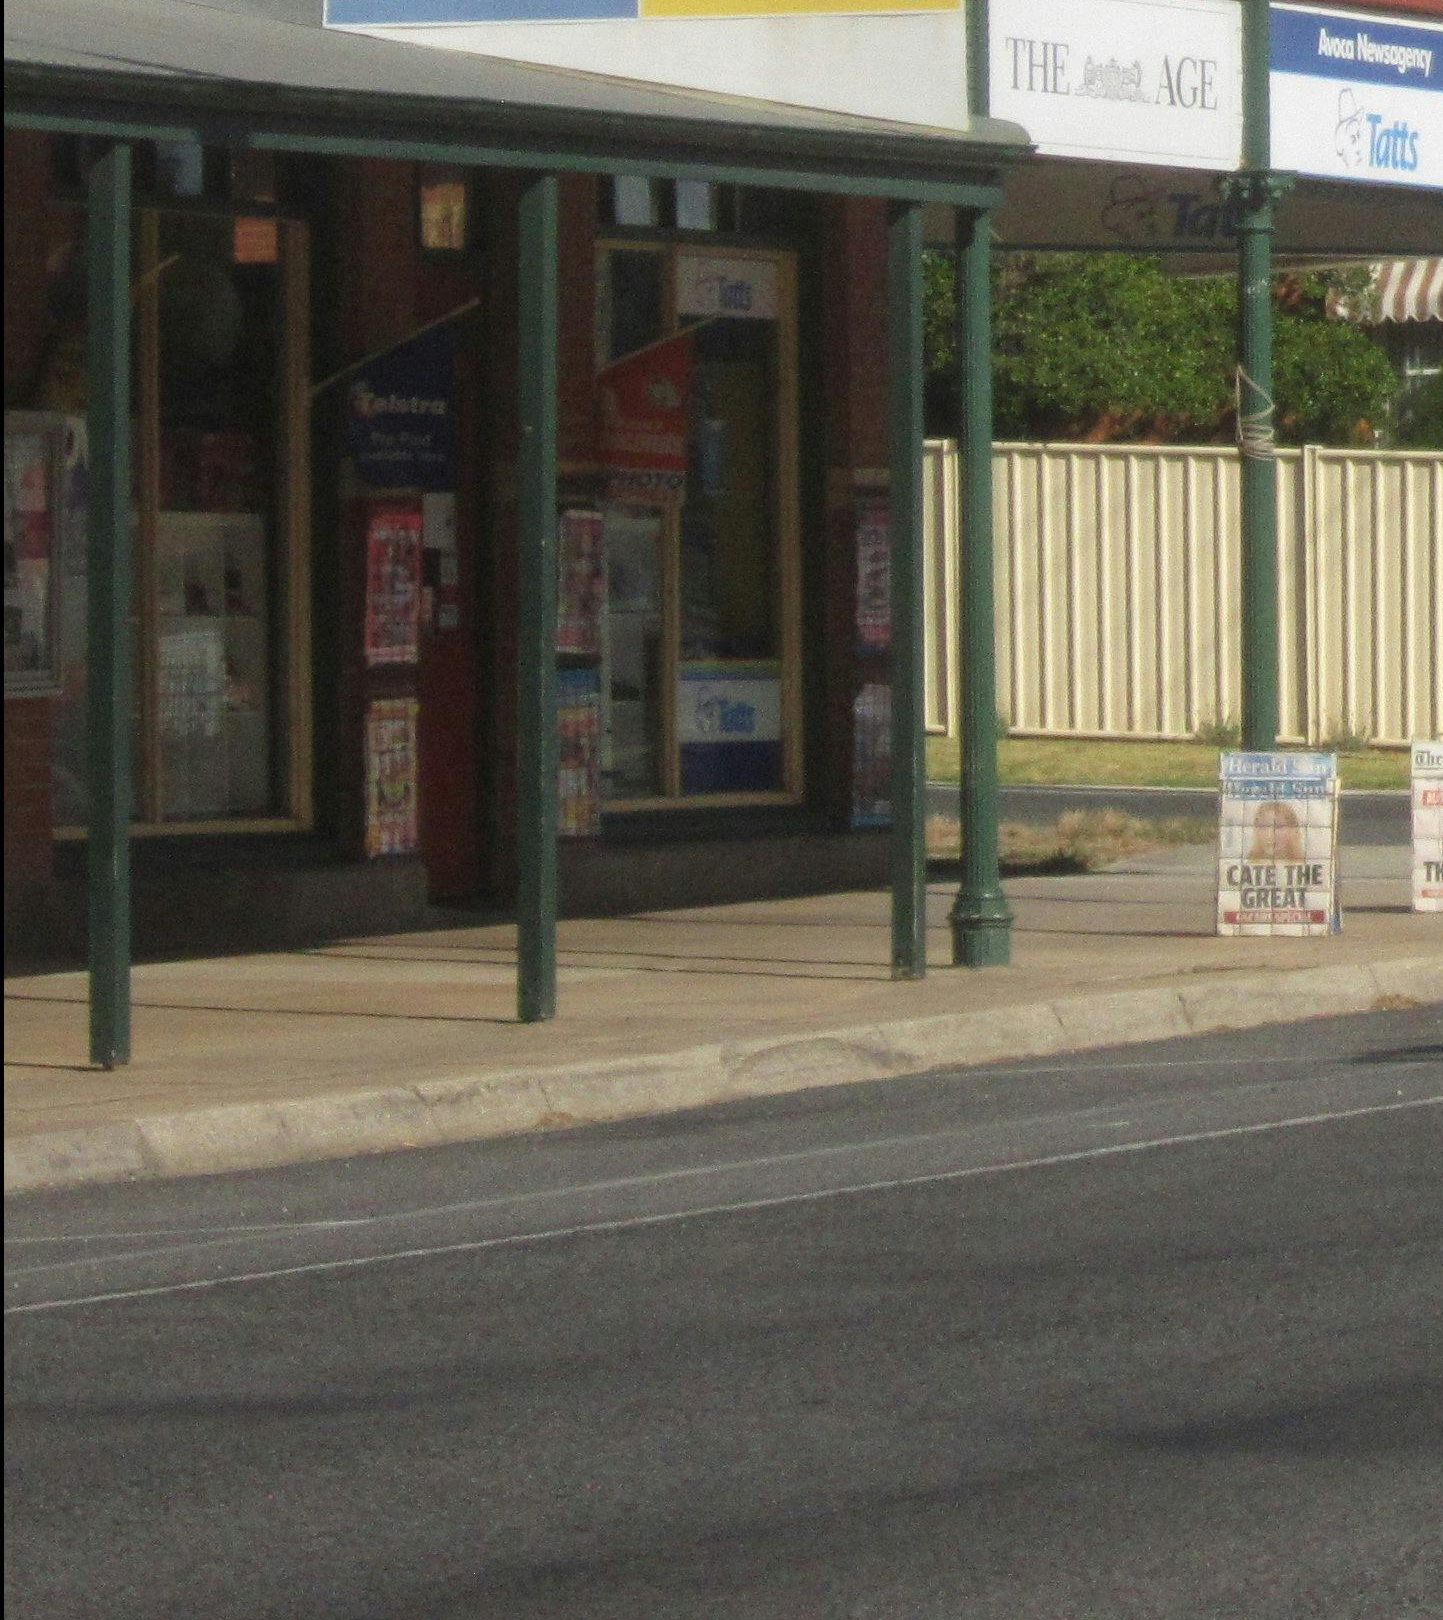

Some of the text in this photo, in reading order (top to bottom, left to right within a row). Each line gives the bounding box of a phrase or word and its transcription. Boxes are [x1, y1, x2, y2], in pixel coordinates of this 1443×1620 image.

[1318, 27, 1433, 77] Avoca Newsagency
[1005, 36, 1219, 112] THE AGE
[1366, 111, 1419, 173] Tatts
[1415, 750, 1443, 766] The
[1226, 864, 1323, 886] CATE THE
[1240, 887, 1308, 908] GREAT
